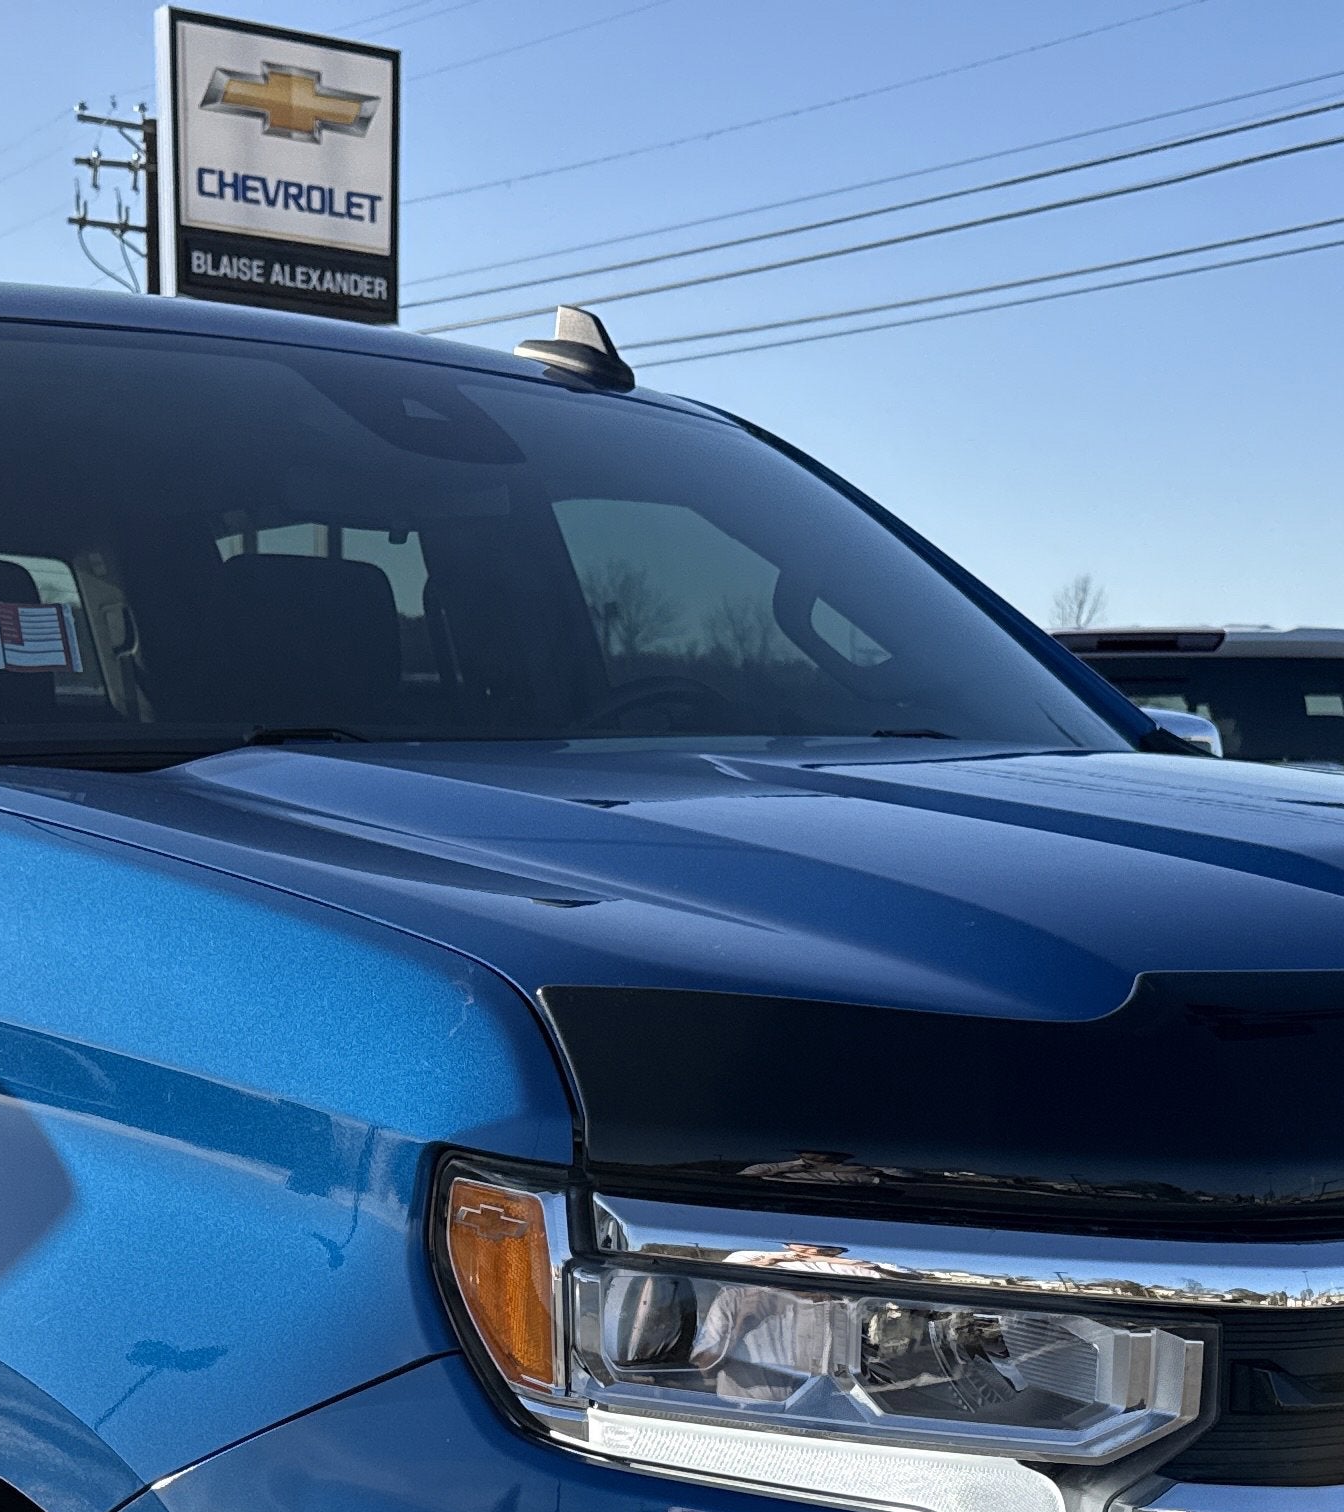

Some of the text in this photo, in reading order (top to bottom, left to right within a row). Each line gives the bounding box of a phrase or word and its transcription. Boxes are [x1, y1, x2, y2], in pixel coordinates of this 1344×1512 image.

[196, 167, 382, 224] CHEVROLET
[191, 250, 388, 300] BLAISE ALEXANDER
